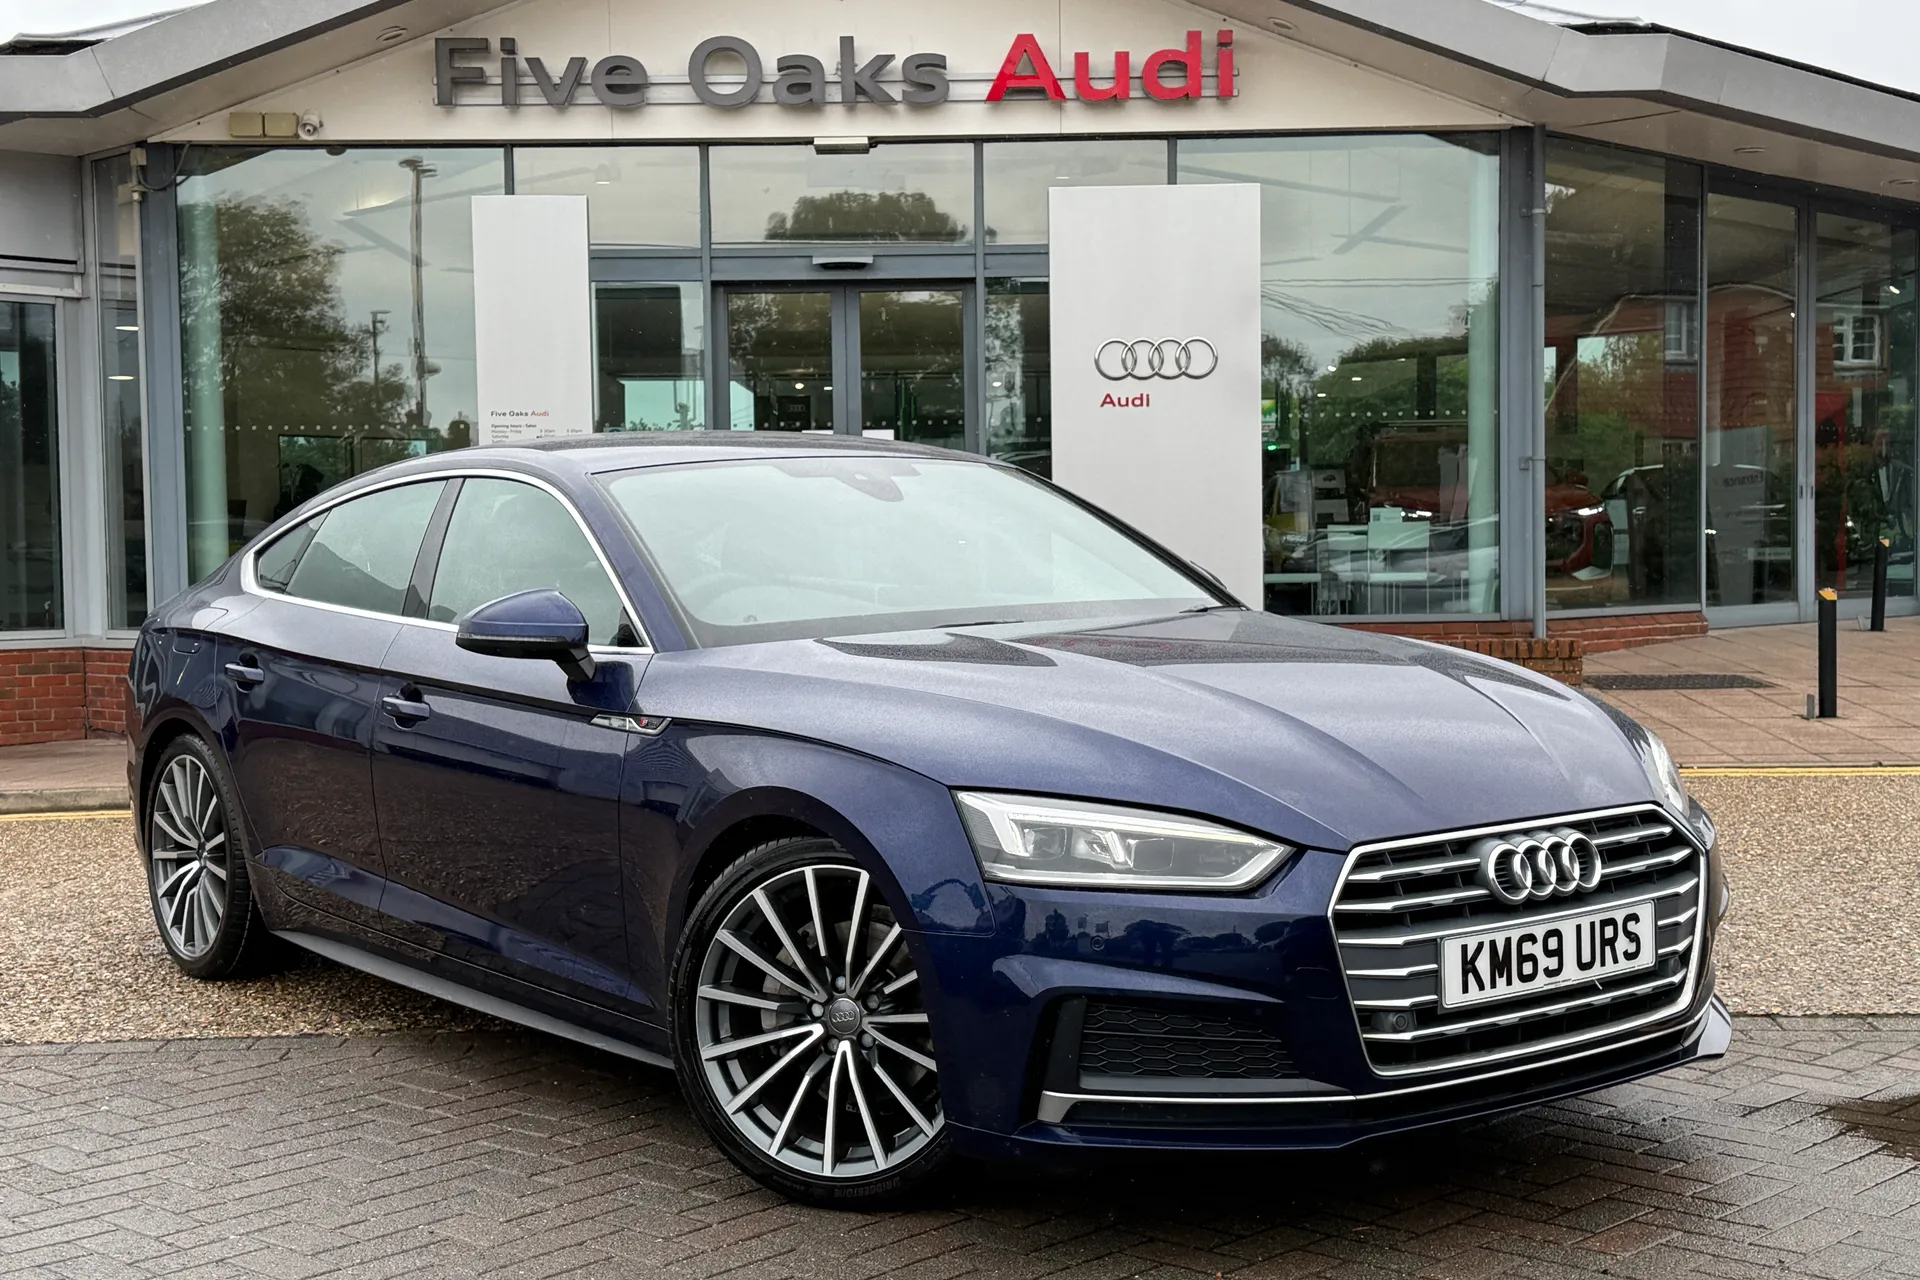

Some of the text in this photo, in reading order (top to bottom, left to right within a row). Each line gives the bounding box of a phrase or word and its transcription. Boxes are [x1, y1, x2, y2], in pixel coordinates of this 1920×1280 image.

[434, 29, 1234, 107] Five Oaks Audi
[1100, 393, 1150, 407] Audi
[1460, 912, 1642, 995] KM69 URS
